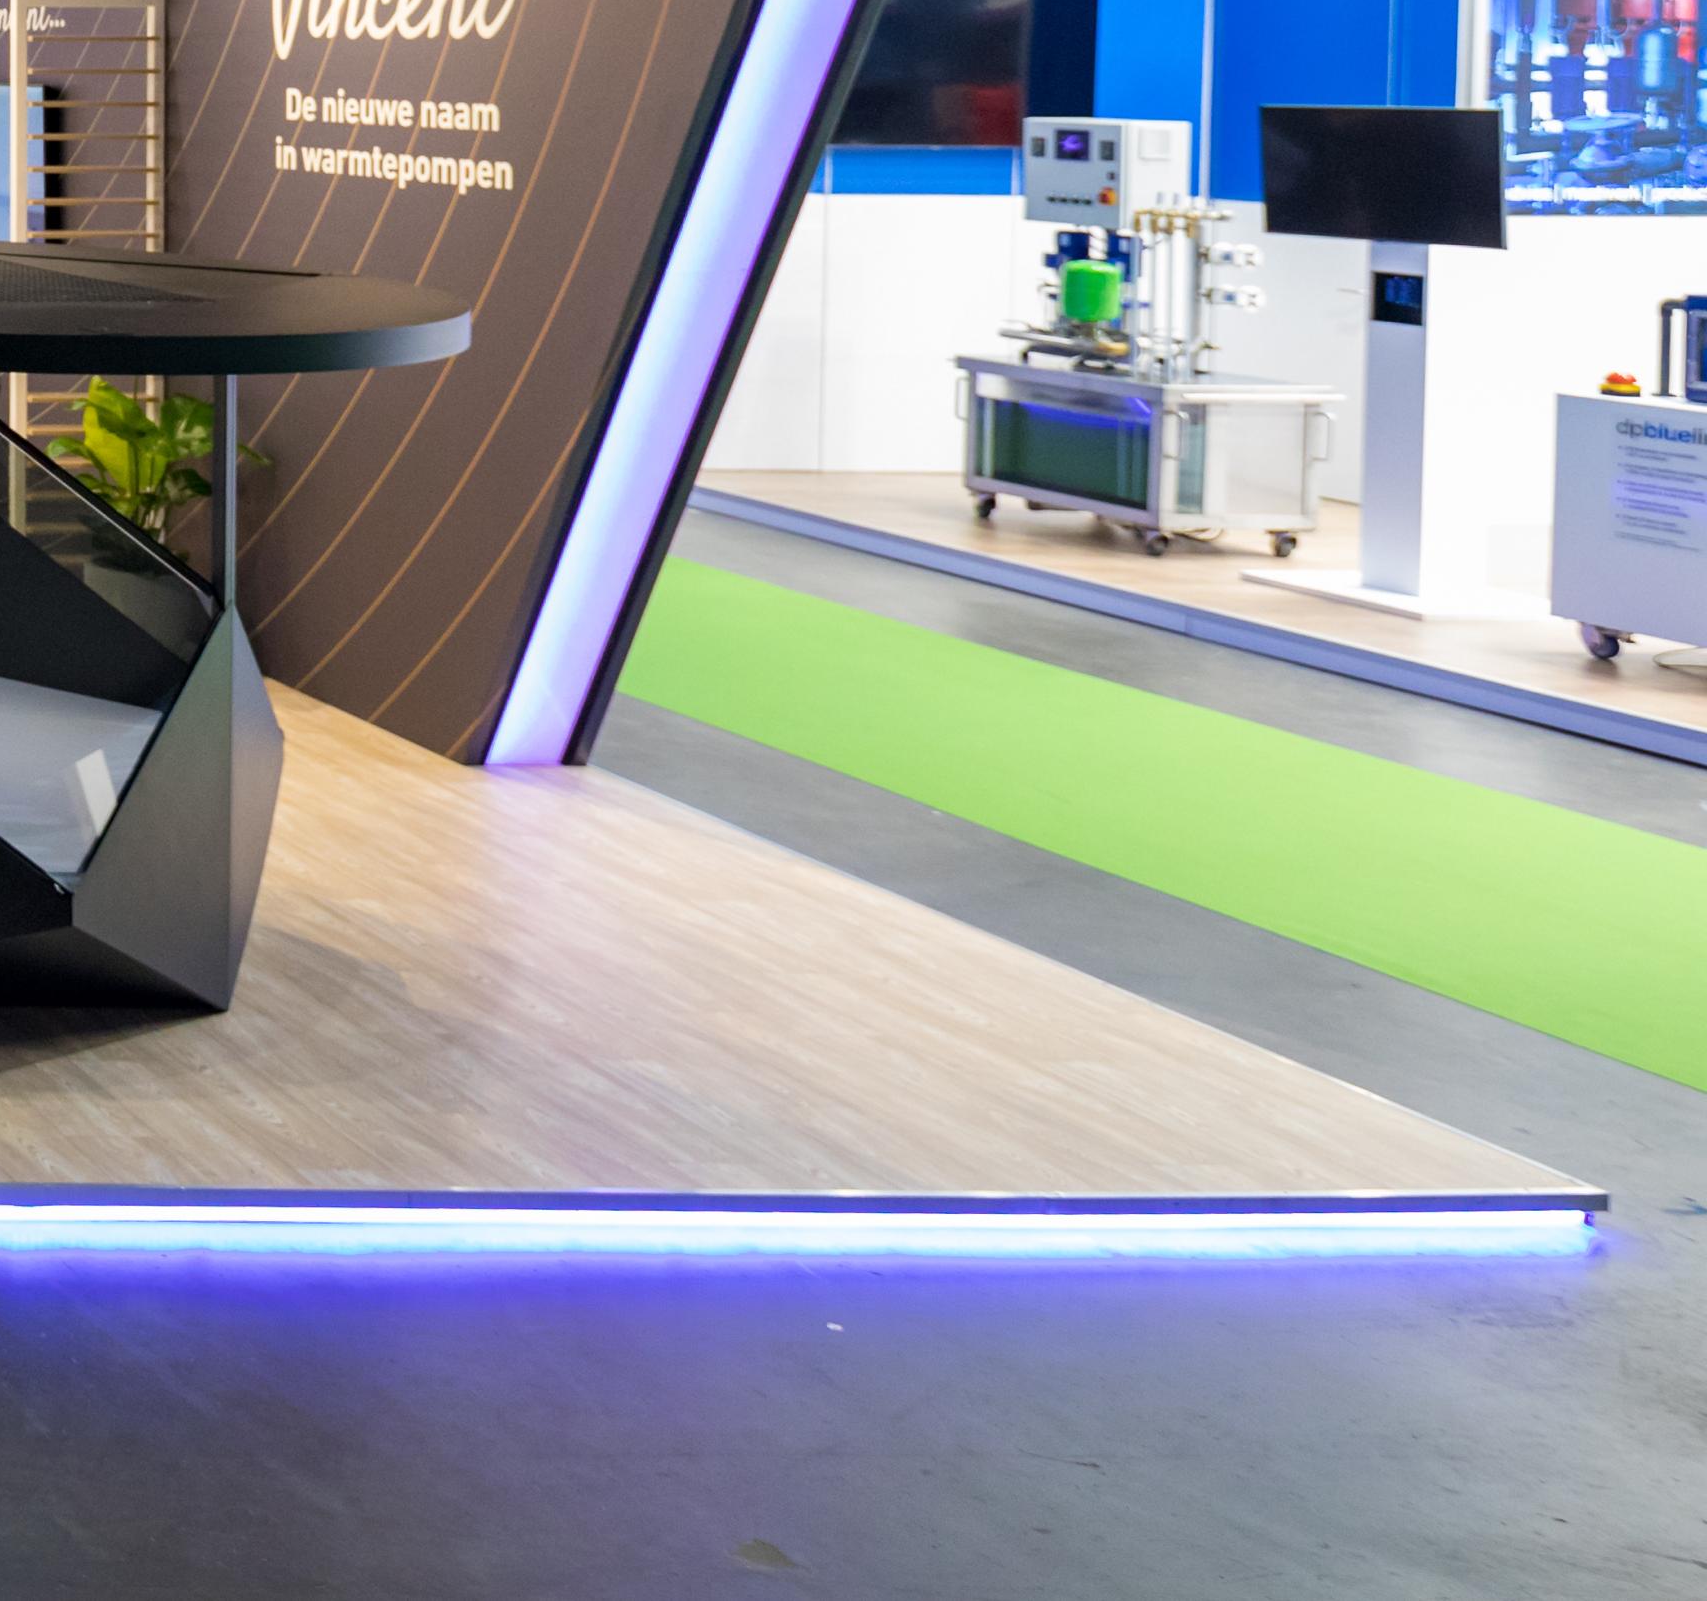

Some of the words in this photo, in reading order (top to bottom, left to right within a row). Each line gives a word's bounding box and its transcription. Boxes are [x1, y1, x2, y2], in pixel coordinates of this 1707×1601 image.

[284, 86, 317, 123] De
[322, 86, 414, 128] nieuwe
[420, 95, 501, 132] naam
[275, 137, 298, 173] in
[301, 142, 514, 196] warmtepompen
